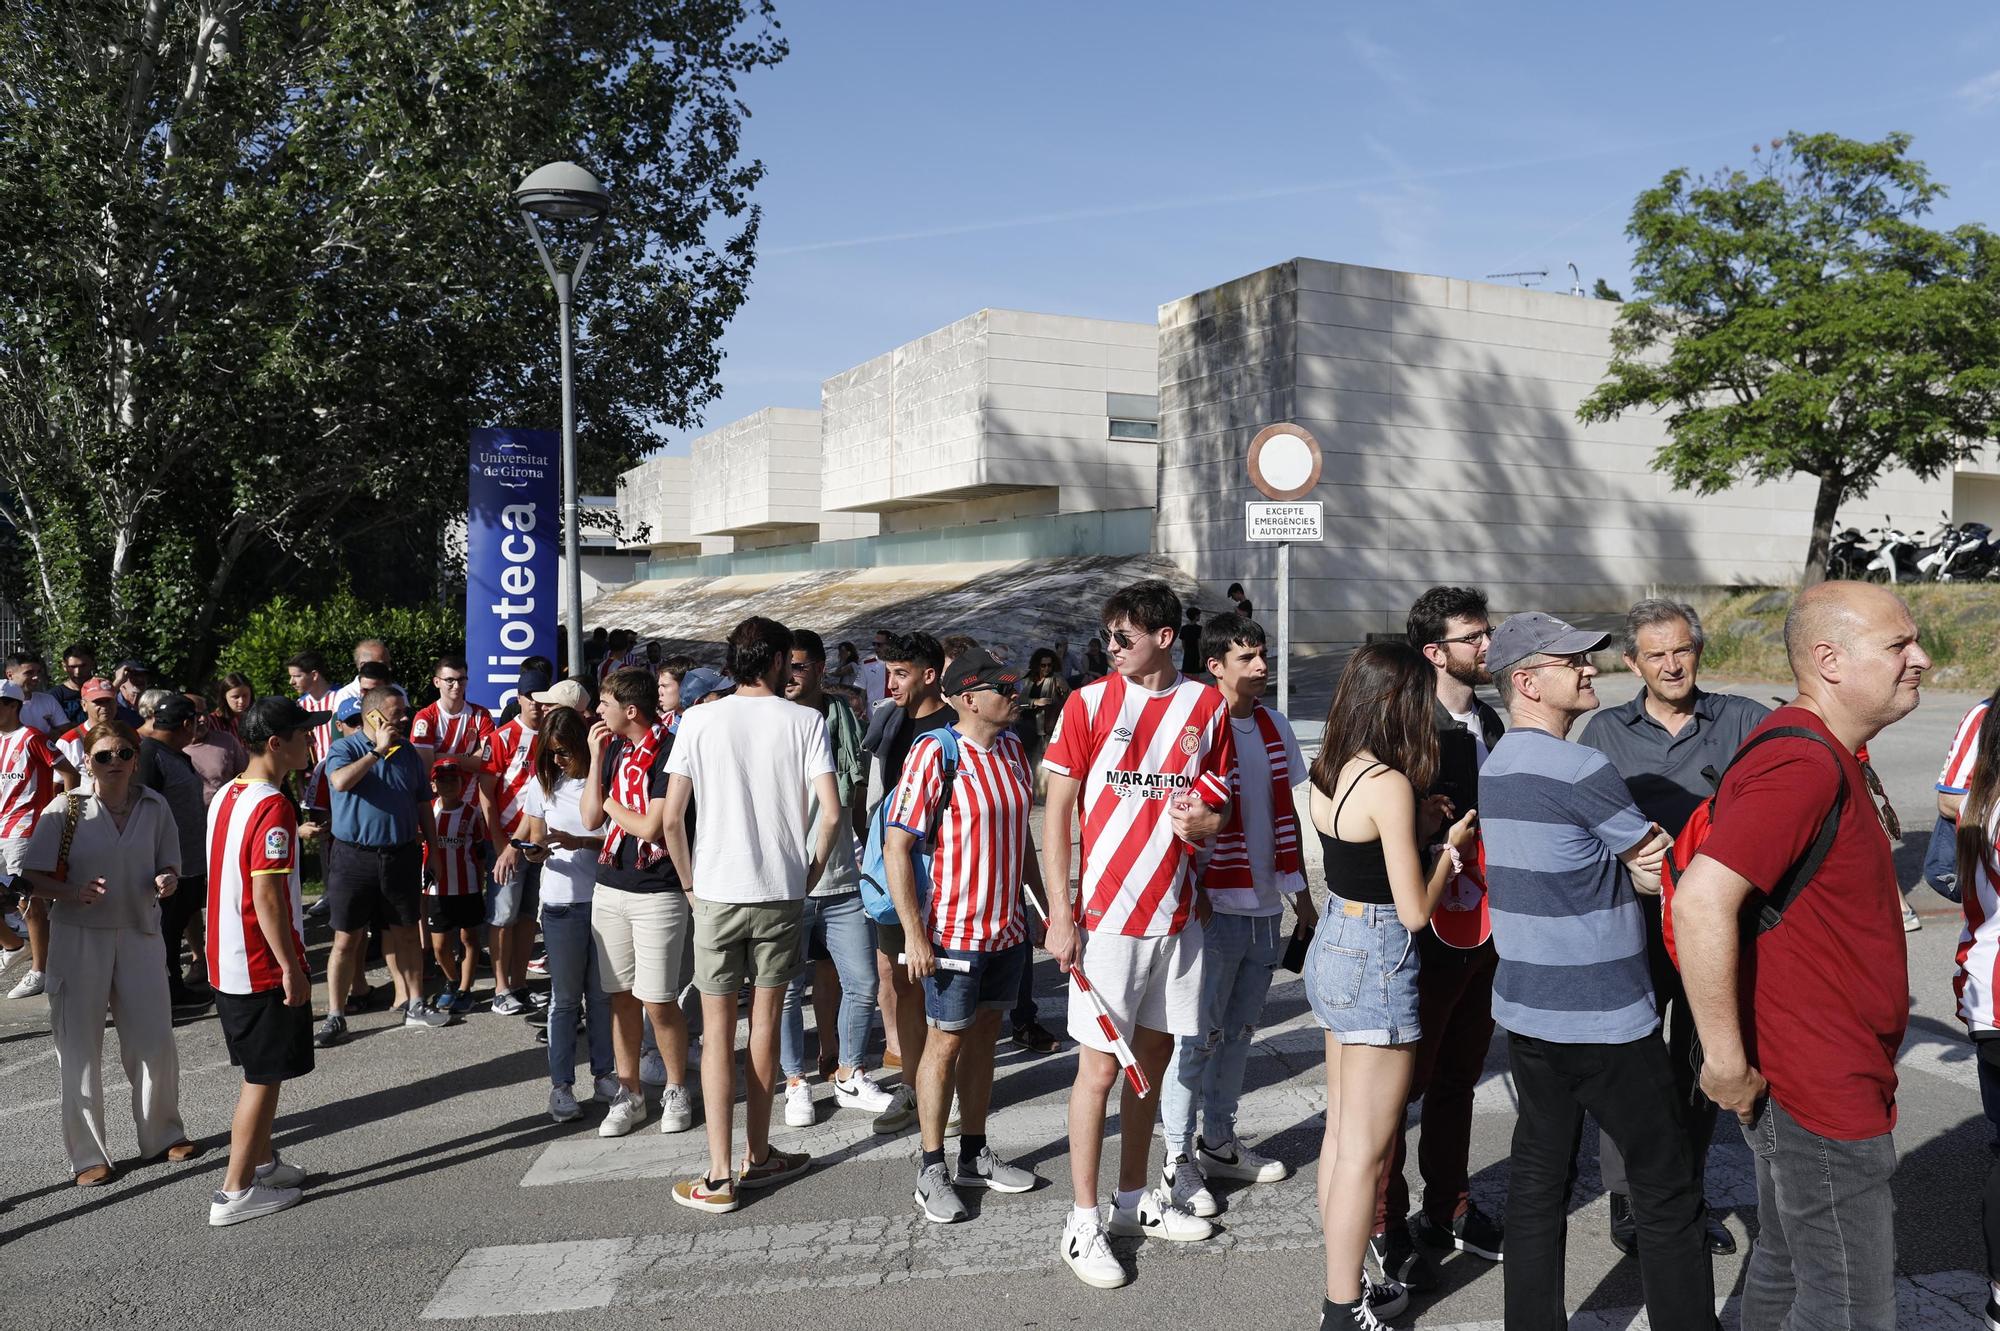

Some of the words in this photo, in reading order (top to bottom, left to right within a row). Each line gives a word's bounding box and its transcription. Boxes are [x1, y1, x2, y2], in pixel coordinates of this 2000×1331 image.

[479, 452, 549, 466] Universitat
[483, 465, 499, 477] de
[500, 466, 544, 479] Girona
[1259, 527, 1318, 536] AUTORITZATS
[1106, 771, 1195, 789] MARATHON
[1141, 789, 1164, 799] BET
